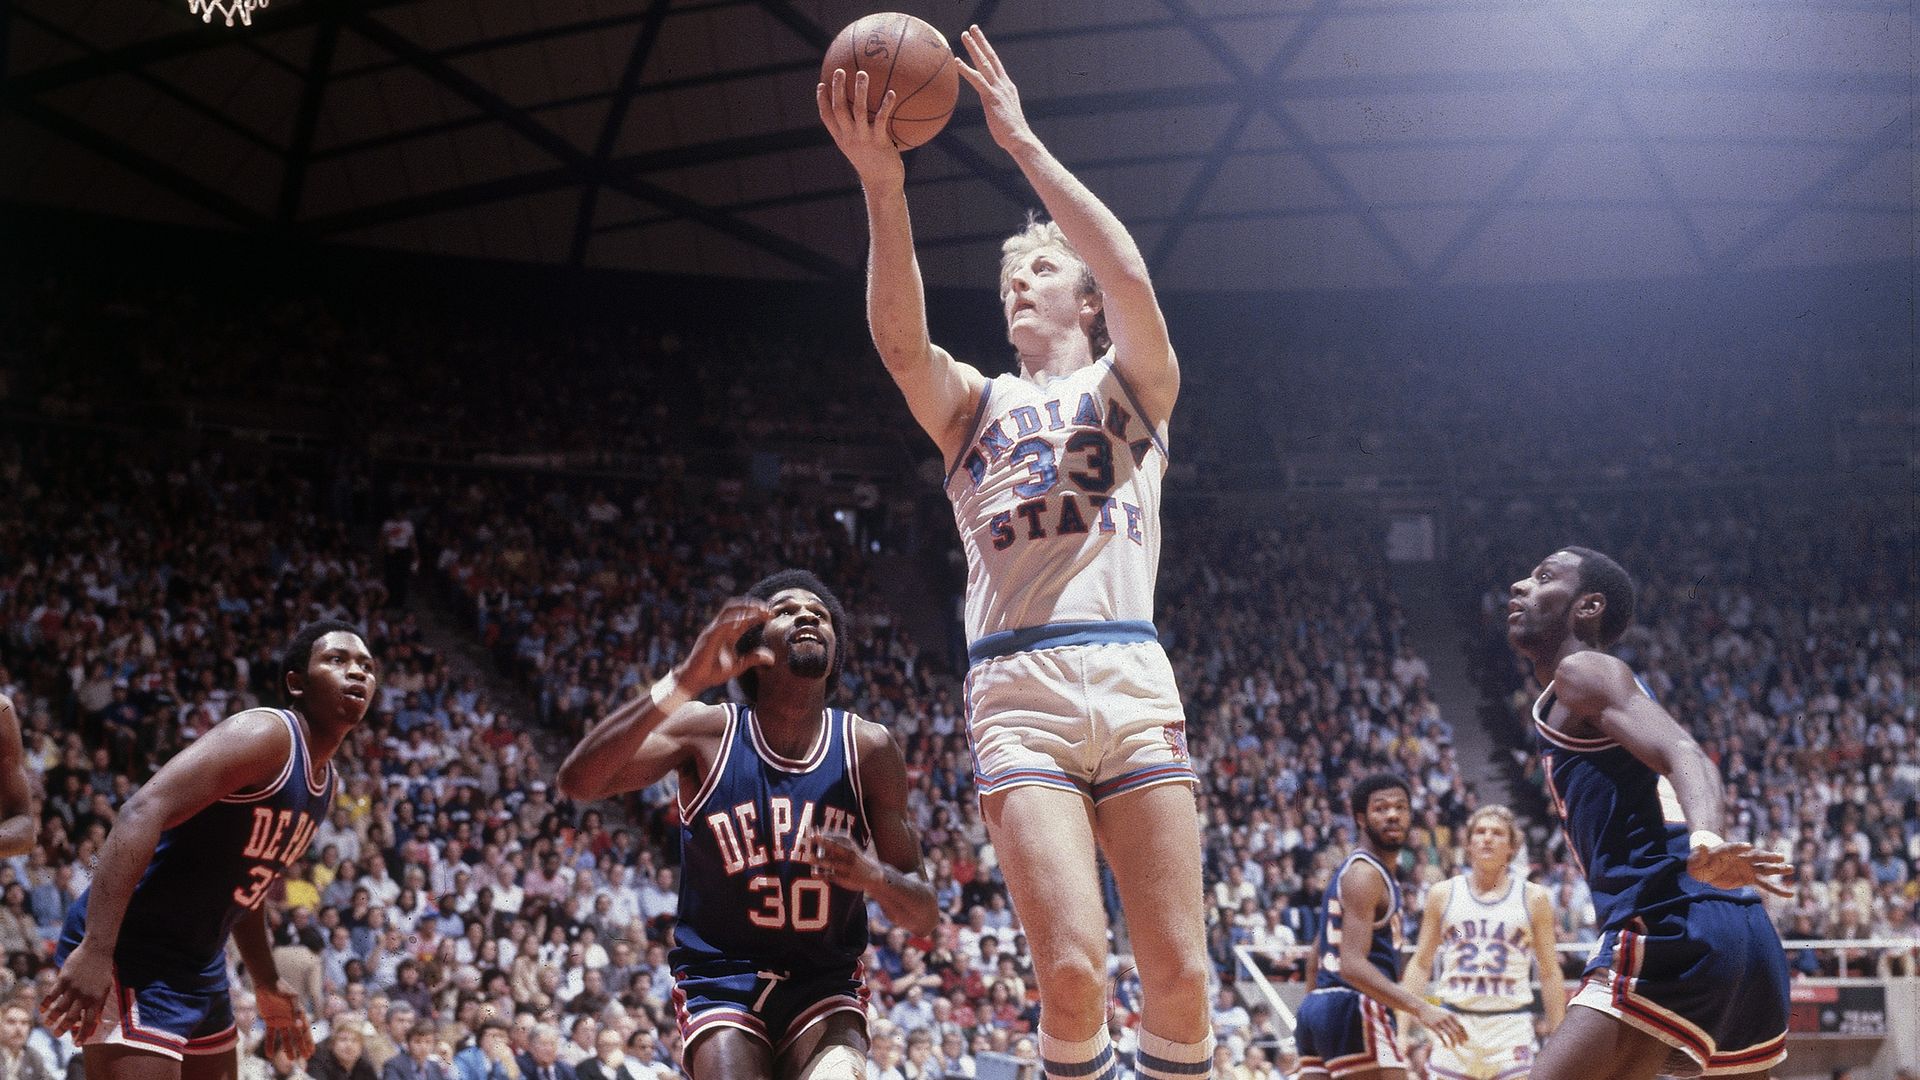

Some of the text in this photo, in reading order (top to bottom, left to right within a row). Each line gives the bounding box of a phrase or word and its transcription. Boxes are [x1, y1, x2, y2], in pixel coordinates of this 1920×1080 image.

[963, 392, 1153, 492] INDIANA
[1009, 430, 1115, 500] 33
[989, 495, 1142, 551] STATE
[233, 864, 281, 911] 3
[748, 875, 831, 933] 30
[1455, 941, 1509, 974] 23
